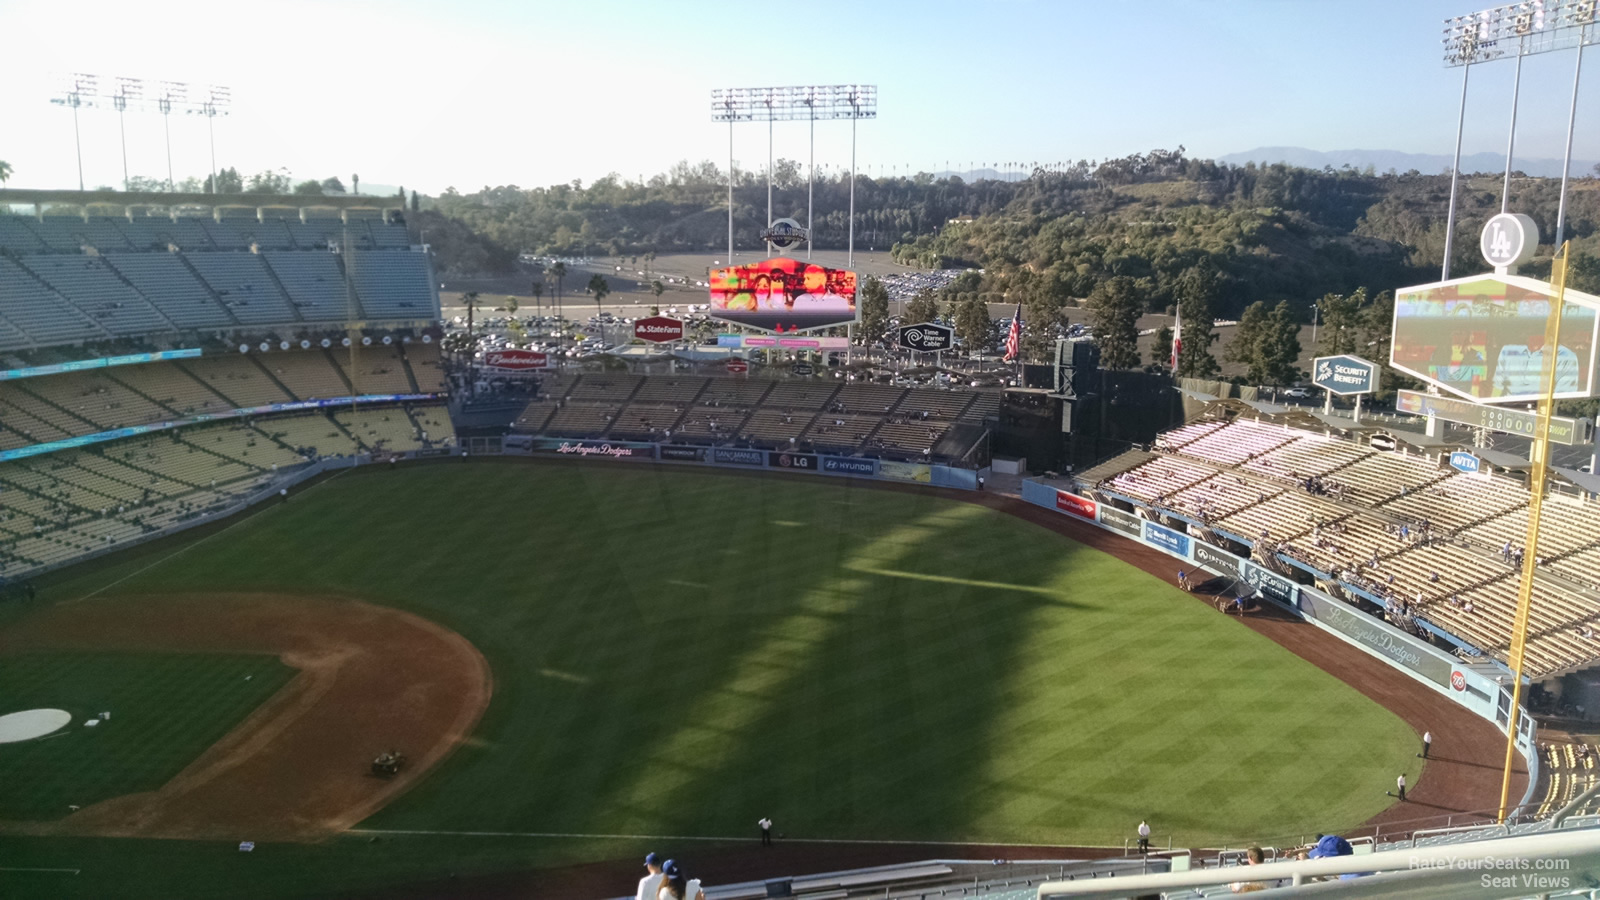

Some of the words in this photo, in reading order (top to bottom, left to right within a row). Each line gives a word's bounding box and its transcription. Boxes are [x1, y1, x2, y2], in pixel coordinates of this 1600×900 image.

[1490, 222, 1511, 258] LA
[1334, 364, 1368, 377] SECURITY
[1334, 374, 1363, 385] BENEFIT
[557, 442, 572, 454] Los
[570, 443, 600, 456] Angeles
[600, 443, 632, 457] Dodgers
[794, 458, 808, 468] LG
[839, 463, 873, 472] HYUNDAI
[1452, 456, 1476, 469] AVITA
[1342, 618, 1379, 645] Angeles
[1378, 633, 1420, 666] Dodgers
[1453, 675, 1464, 689] 76
